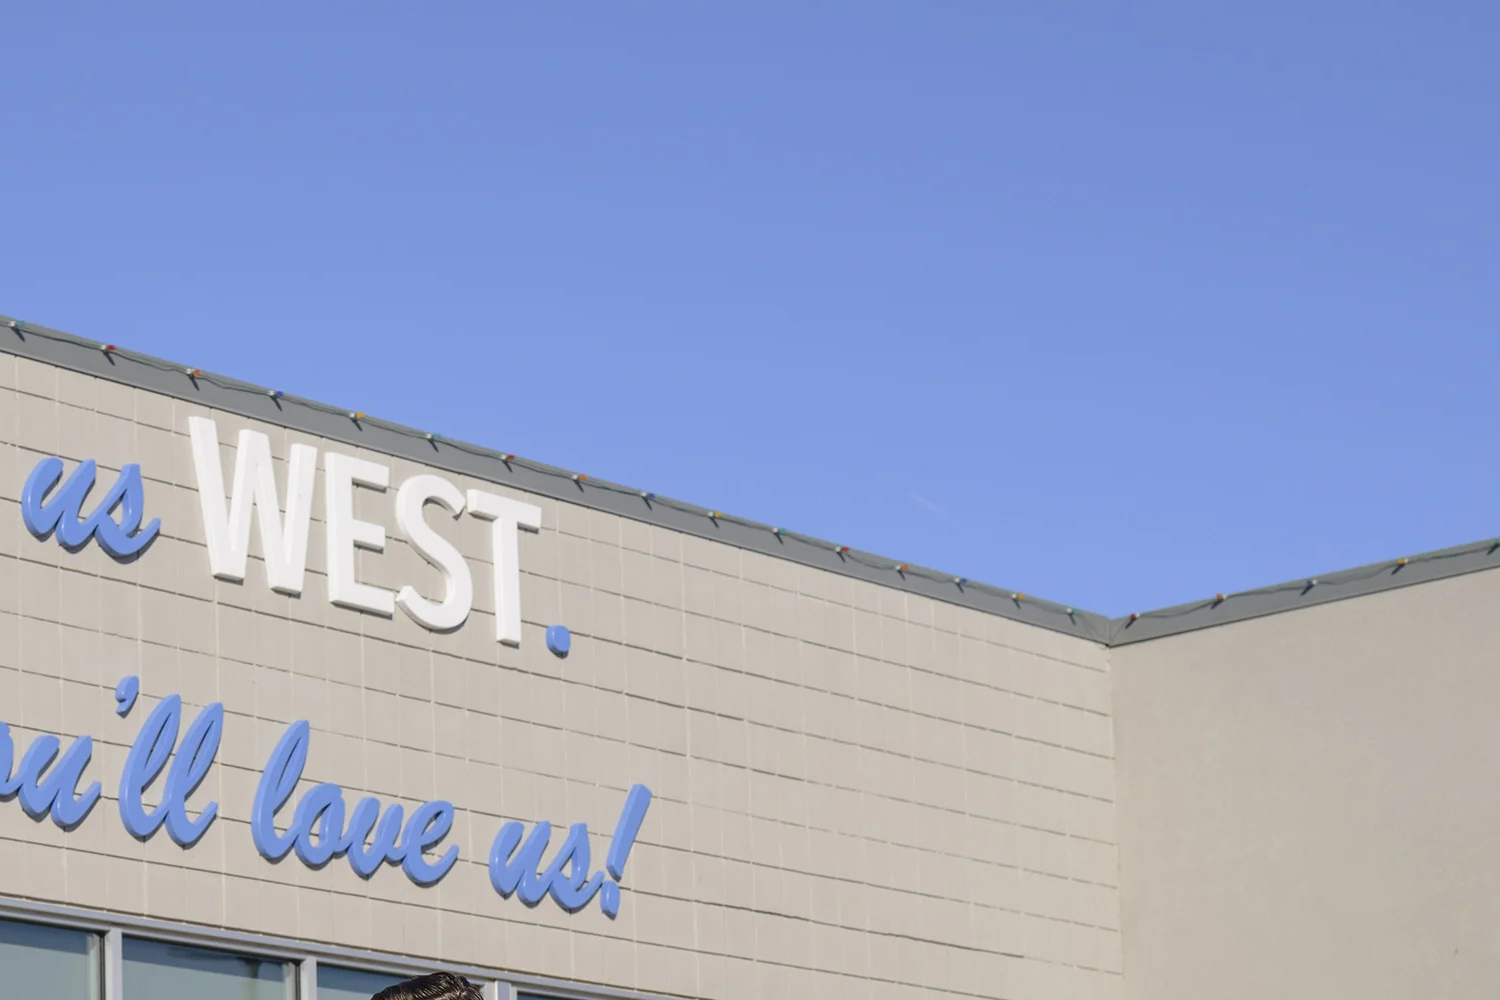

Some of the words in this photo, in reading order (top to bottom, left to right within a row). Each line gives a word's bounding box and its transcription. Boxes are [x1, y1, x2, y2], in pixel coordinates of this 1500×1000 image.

[21, 457, 161, 557] us
[188, 416, 571, 657] WEST.
[251, 719, 460, 886] love
[488, 784, 652, 917] us!
